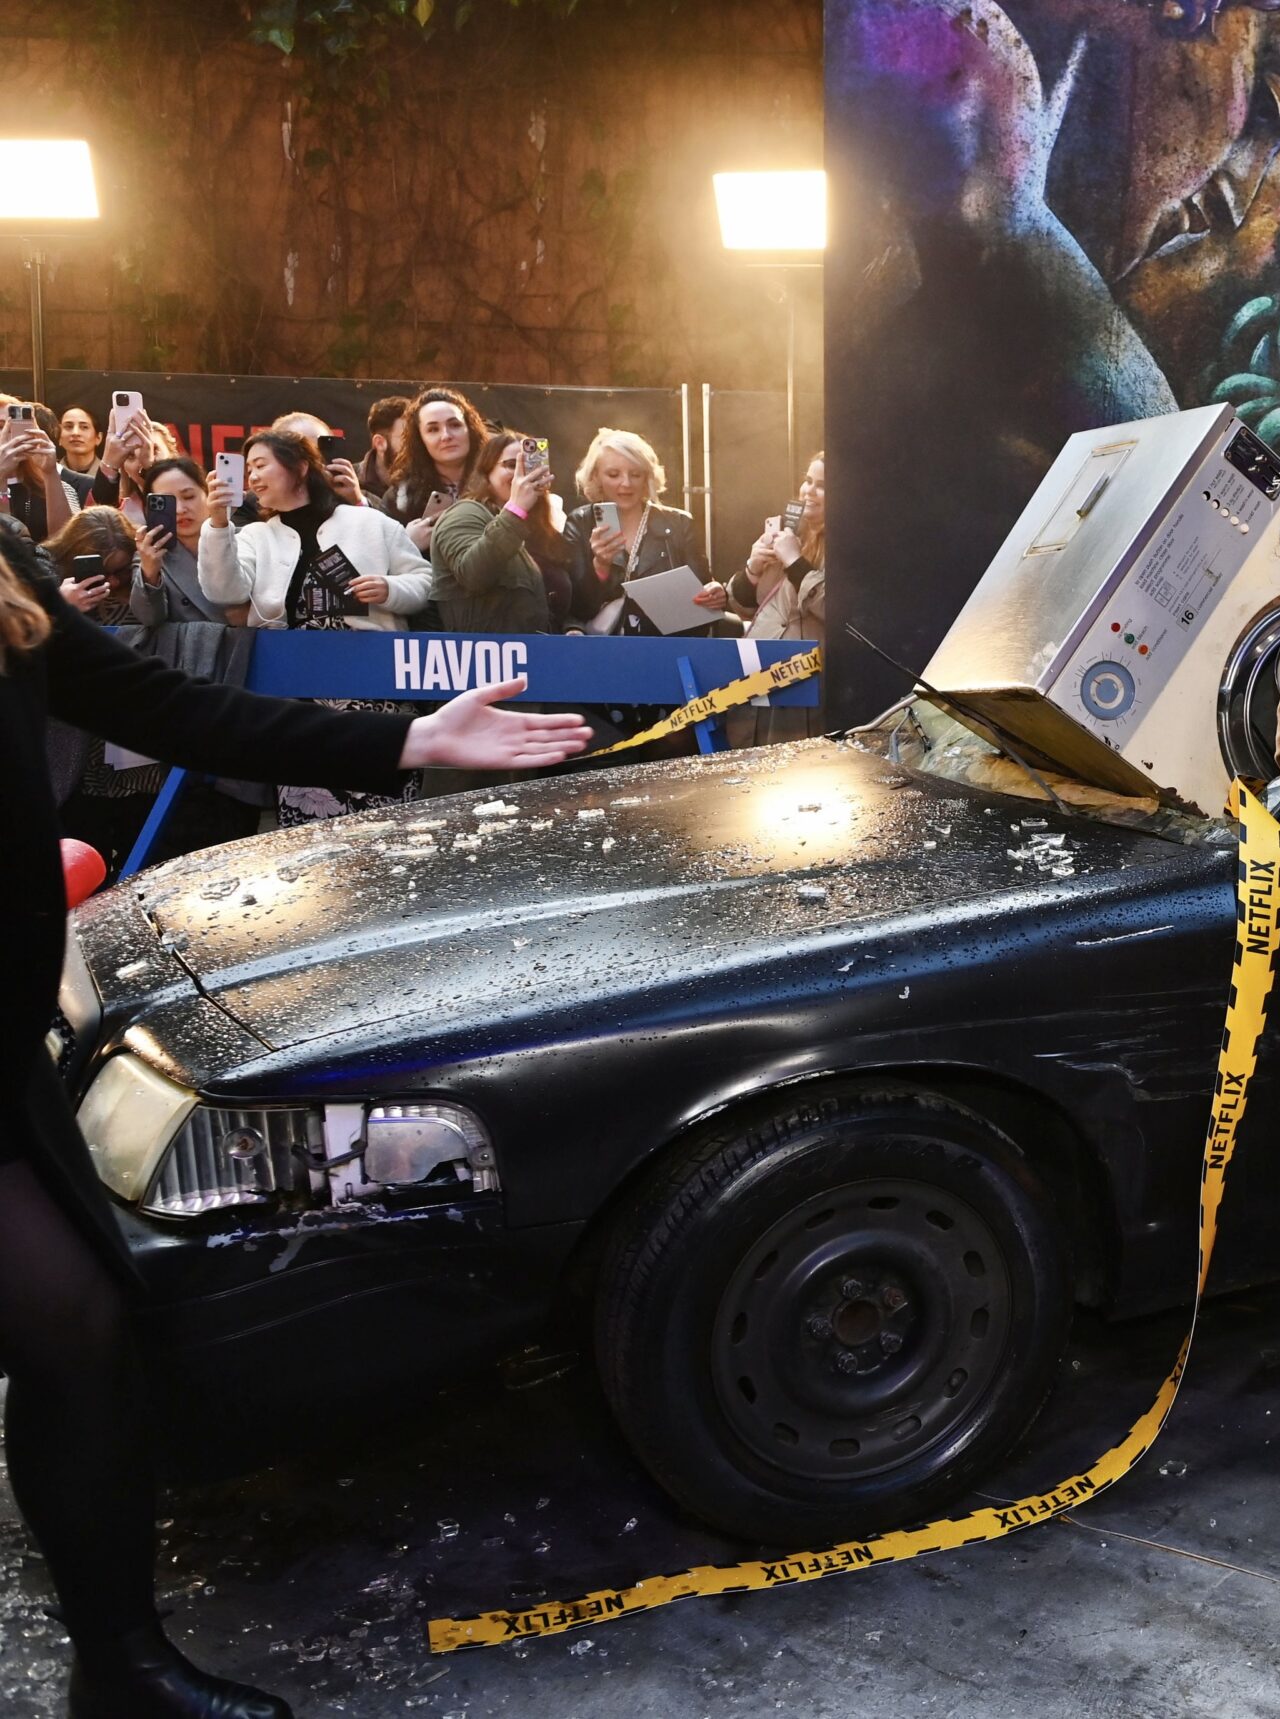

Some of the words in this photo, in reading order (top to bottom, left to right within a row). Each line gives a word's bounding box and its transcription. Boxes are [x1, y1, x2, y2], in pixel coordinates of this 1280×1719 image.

[1181, 610, 1194, 625] 16
[394, 639, 528, 692] HAVOC
[770, 653, 821, 683] NETFLIX
[670, 697, 716, 728] NETFLIX
[1246, 859, 1276, 955] NETFLIX
[1209, 1071, 1245, 1169] NETFLIX
[992, 1475, 1096, 1528] NETFLIX
[762, 1545, 874, 1582] NETFLIX
[503, 1594, 625, 1635] NETFLIX
